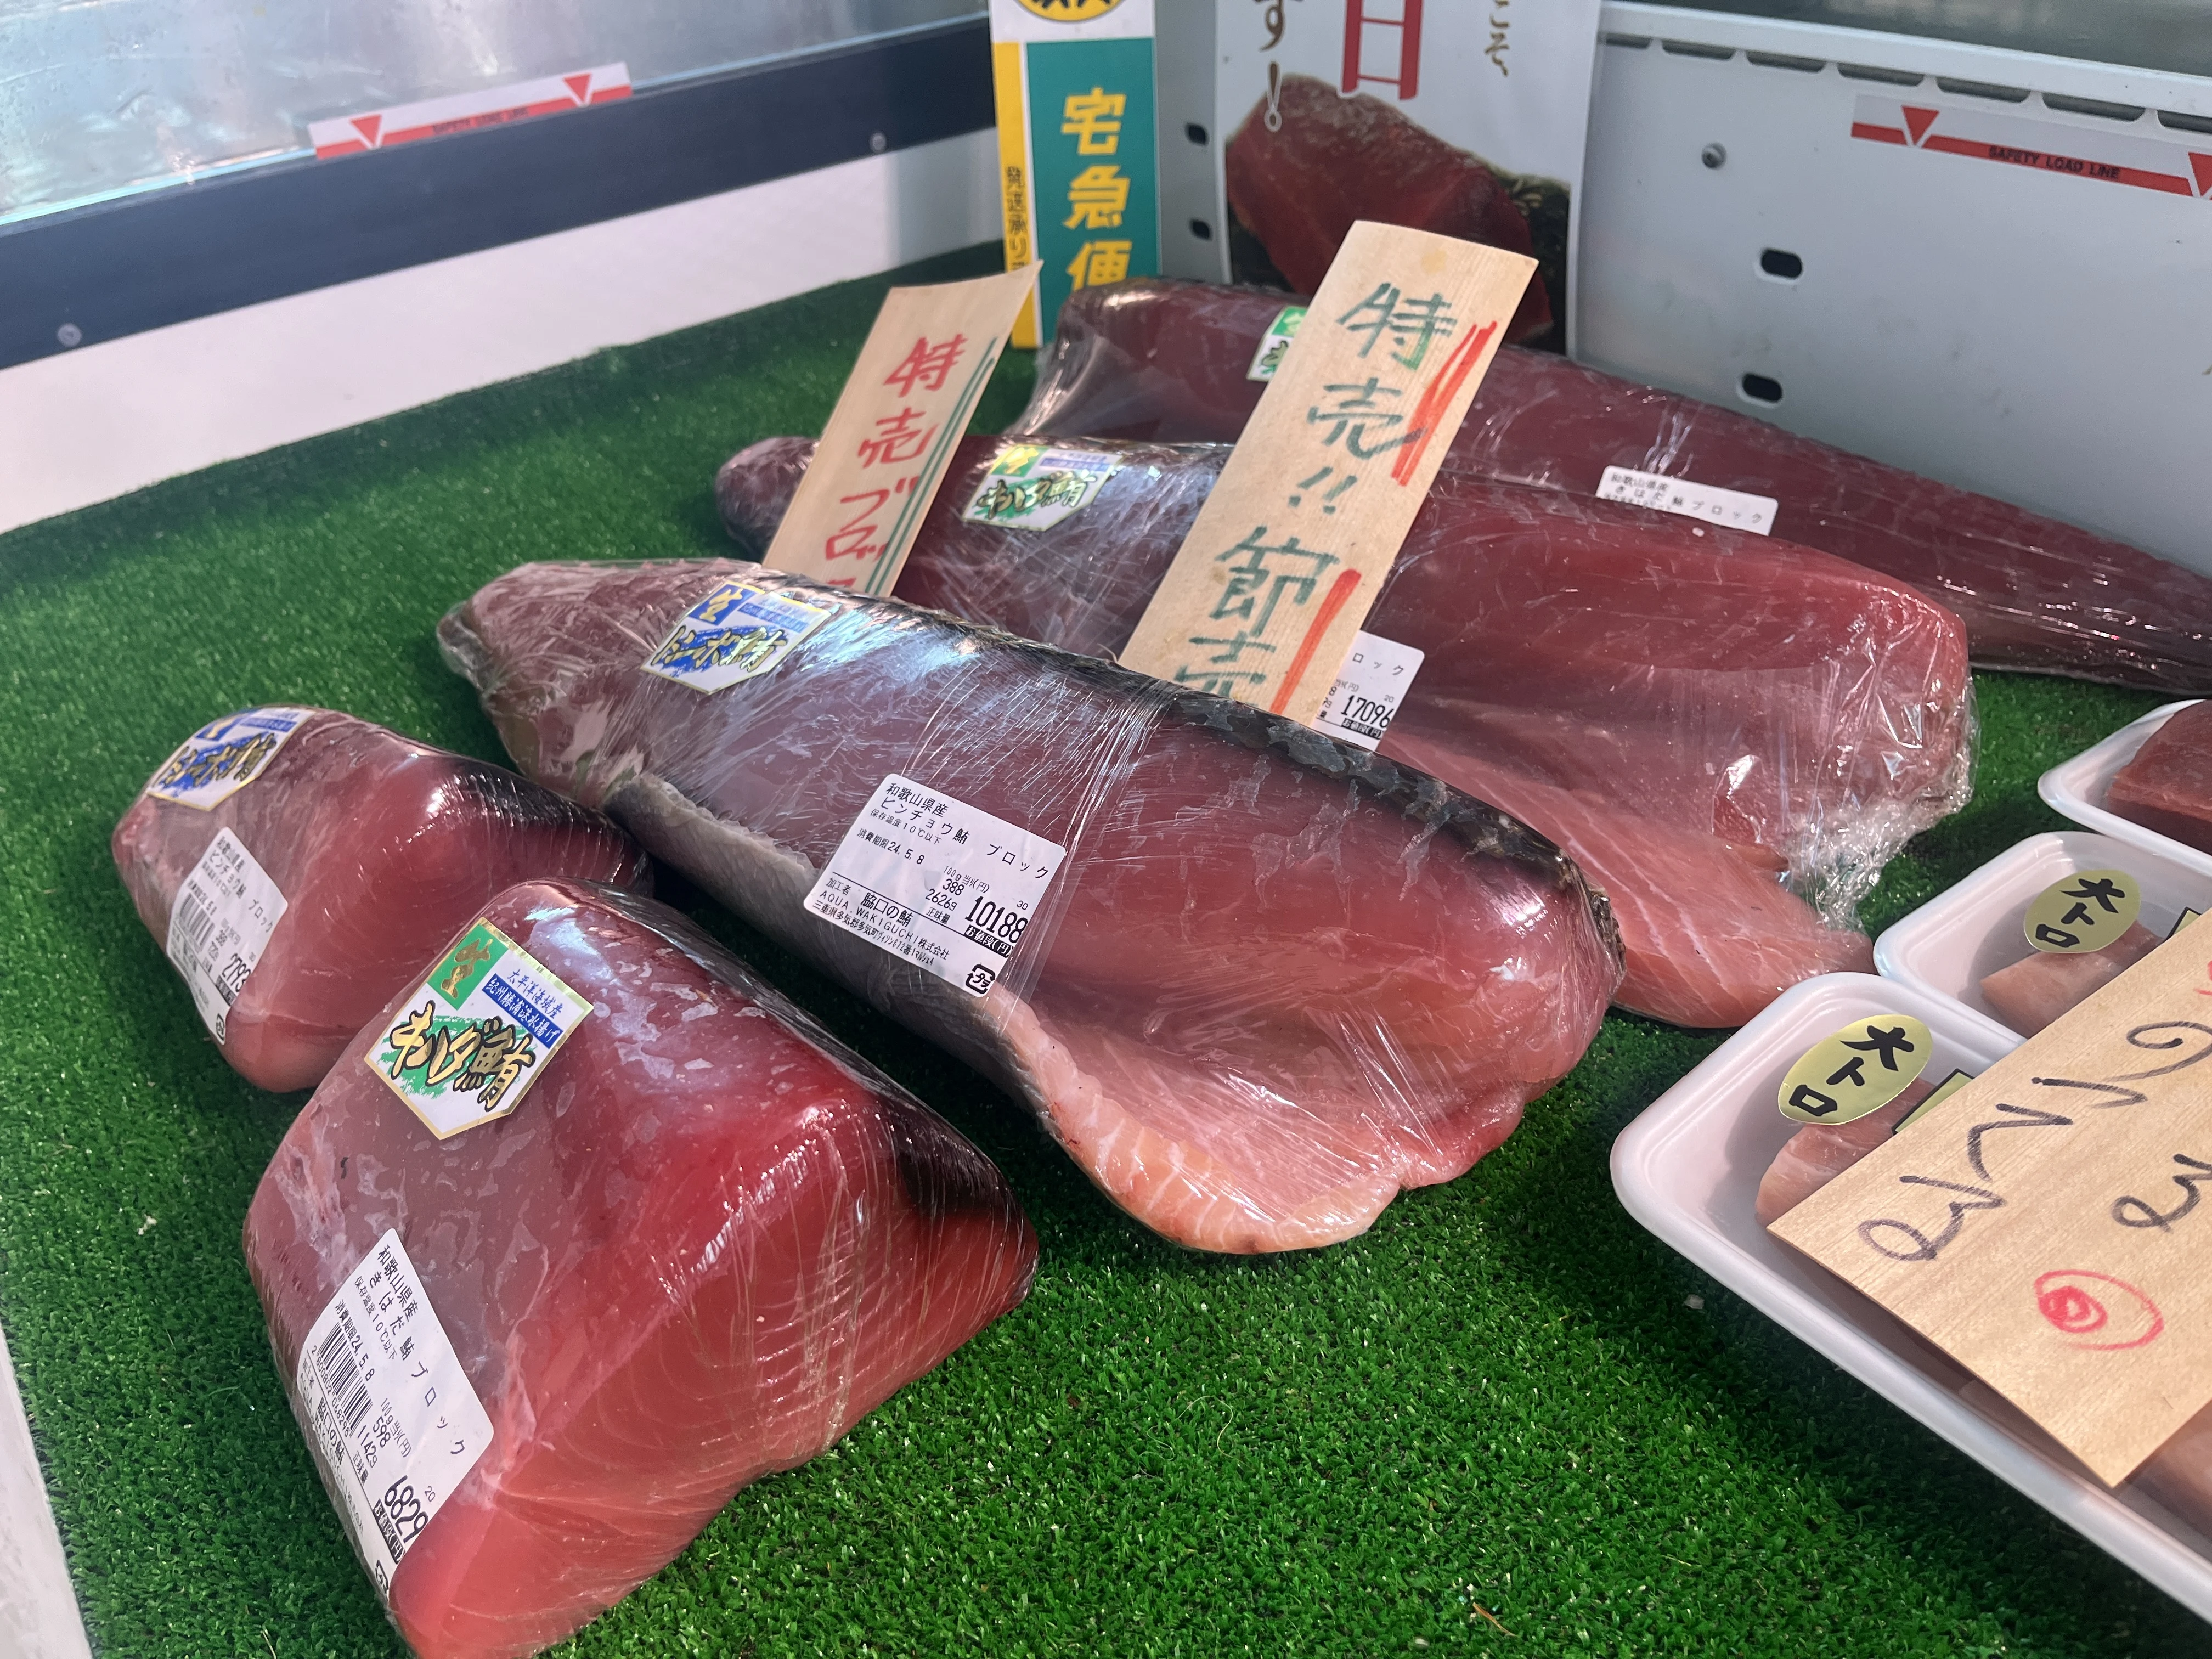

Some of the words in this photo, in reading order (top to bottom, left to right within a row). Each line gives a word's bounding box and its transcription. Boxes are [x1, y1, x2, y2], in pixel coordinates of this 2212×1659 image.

[1989, 145, 2040, 164] SAFETY
[2045, 156, 2083, 173] LOAD
[2089, 162, 2120, 180] LINE
[1060, 87, 1131, 289] 宅急便
[825, 332, 969, 588] 特売ブロッ
[1340, 694, 1395, 729] 17096
[1384, 694, 1395, 703] 20
[885, 782, 950, 818] 和歌山県産
[869, 808, 943, 845] 保存温度10℃以下
[880, 795, 970, 845] ビンチョウ鮪
[986, 843, 1049, 879] ブロック
[826, 877, 852, 896] 加工者
[860, 891, 915, 928] 脇口の鮪
[924, 888, 958, 912] 2626g
[942, 878, 965, 896] 388
[1016, 900, 1029, 911] 30
[248, 899, 274, 933] ブロック
[926, 906, 951, 926] 正味量
[964, 895, 1029, 944] 10188
[2035, 878, 2126, 950] 大トロ
[964, 925, 1013, 957] お値段(円)
[221, 952, 251, 993] 2793
[441, 938, 494, 1000] 生
[486, 977, 561, 1043] 紀州勝浦港水揚げ
[507, 968, 563, 1019] 太平洋海域産
[1788, 1025, 1915, 1117] 大トロ
[377, 1244, 419, 1323] 和歌山県産
[354, 1275, 398, 1361] 保存温度10℃以下
[311, 1345, 318, 1355] 2
[315, 1356, 333, 1396] 800802
[357, 1424, 378, 1468] 1142g
[373, 1415, 391, 1448] 598
[353, 1450, 369, 1486] 正味量
[384, 1474, 428, 1544] 6829
[424, 1485, 436, 1502] 20
[374, 1501, 406, 1564] お値段(円)
